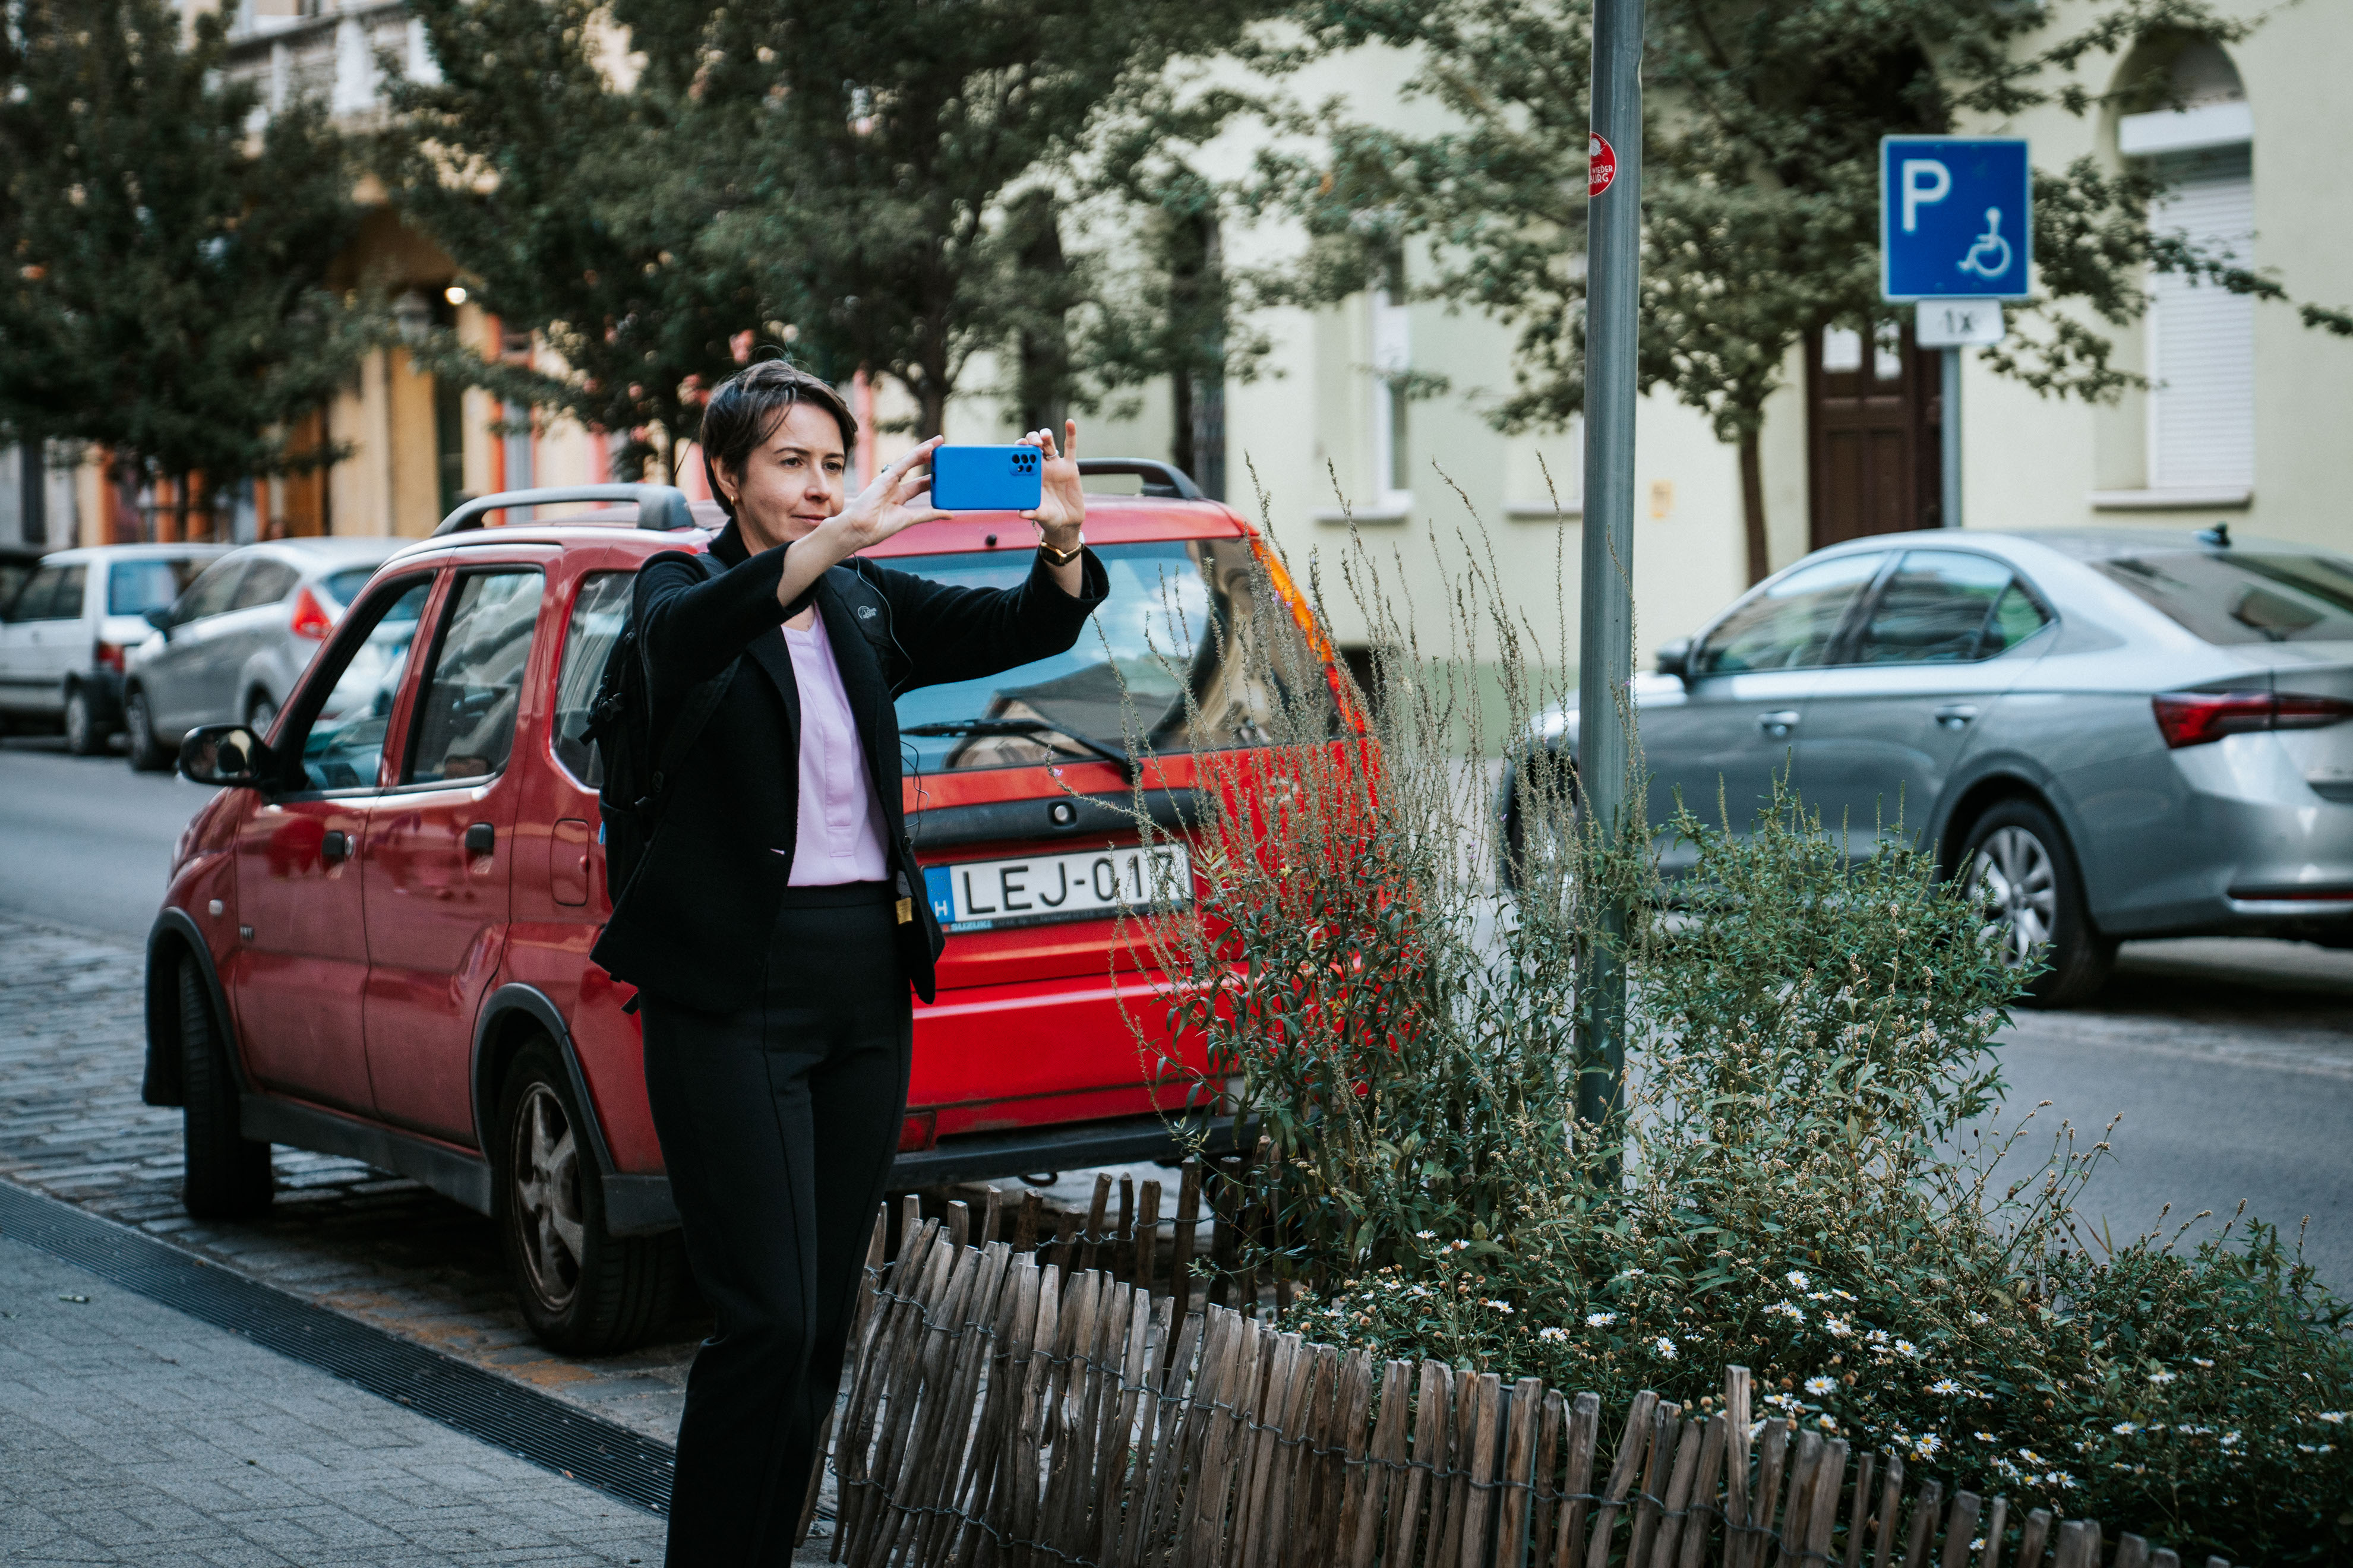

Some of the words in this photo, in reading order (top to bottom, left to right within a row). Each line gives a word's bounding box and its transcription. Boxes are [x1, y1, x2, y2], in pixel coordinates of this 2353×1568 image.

[1592, 165, 1613, 173] WIEDER
[1902, 158, 1951, 232] P
[934, 900, 948, 917] H
[950, 919, 992, 932] SUZUKI
